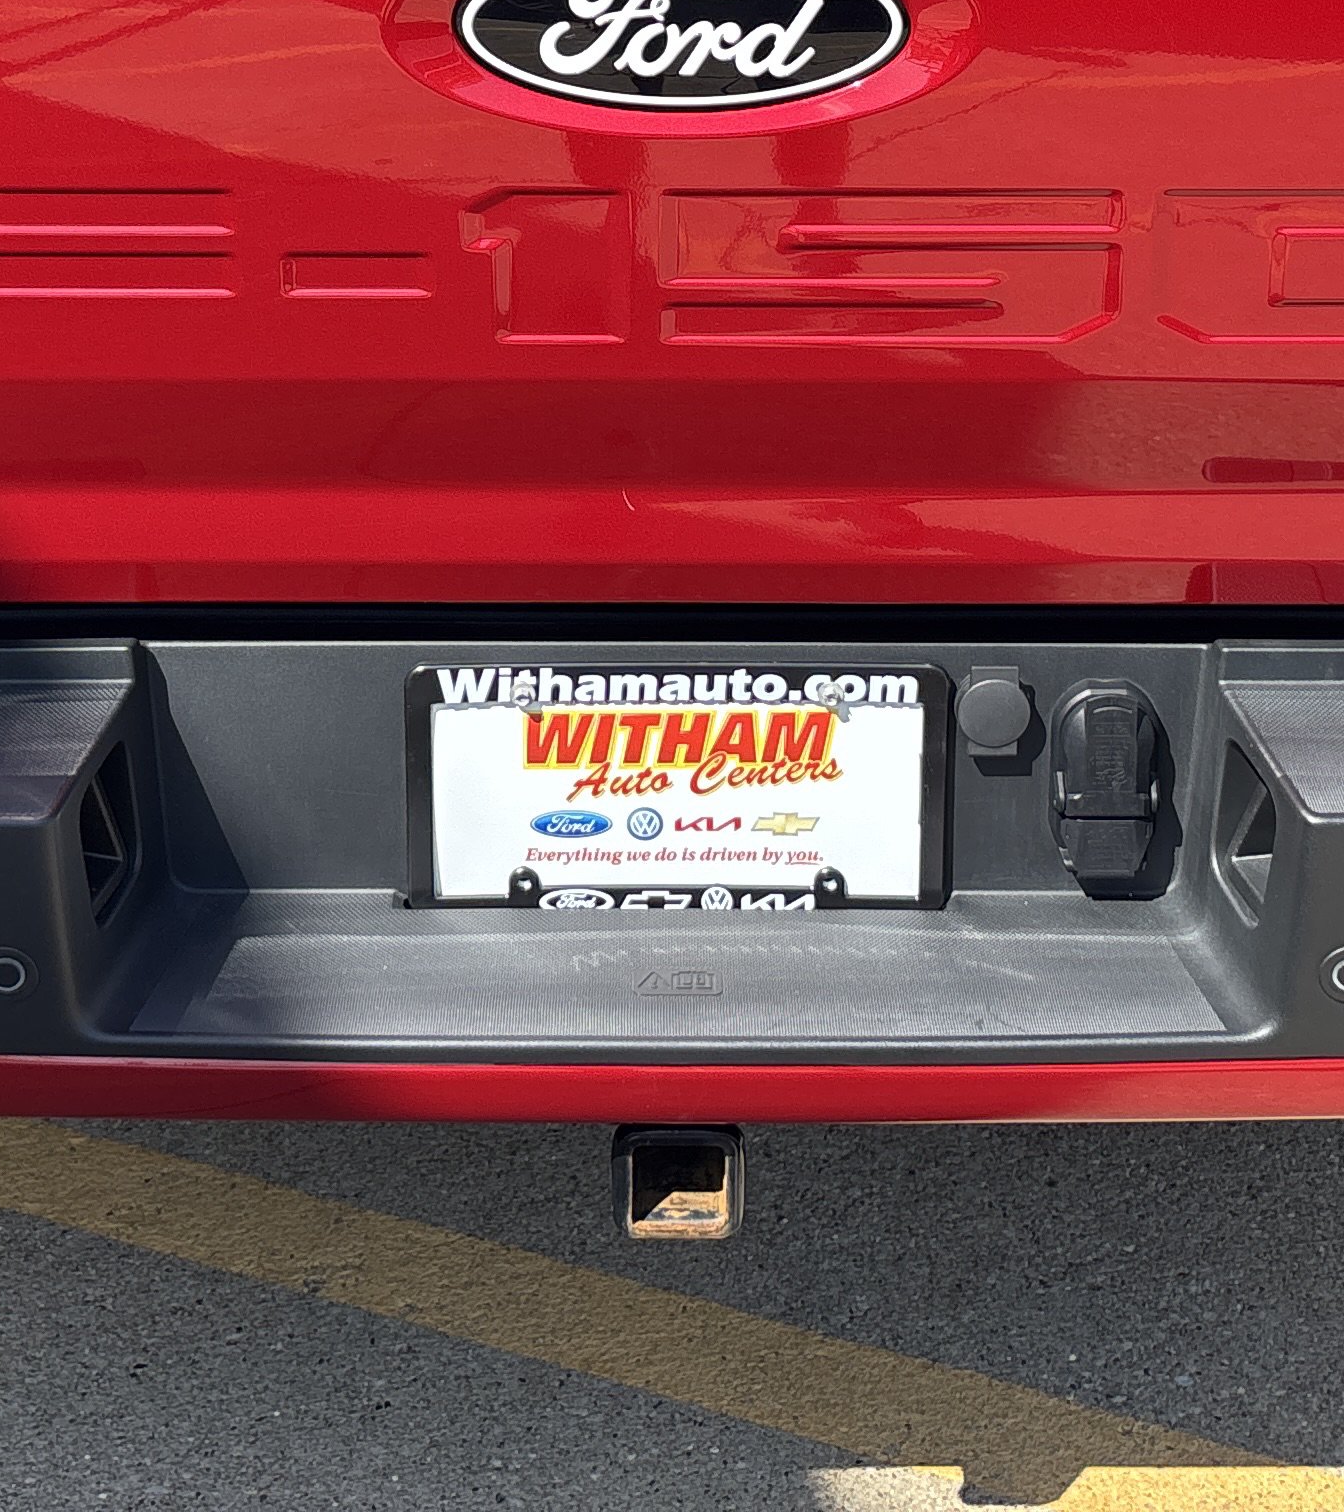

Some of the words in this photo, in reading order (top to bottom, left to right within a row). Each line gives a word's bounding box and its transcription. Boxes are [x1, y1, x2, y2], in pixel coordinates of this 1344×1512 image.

[437, 667, 918, 705] Withamauto.com
[524, 710, 836, 769] WITHAM
[566, 763, 673, 803] Auto
[689, 752, 845, 796] Centers
[525, 846, 624, 866] Everything
[626, 849, 653, 862] we
[654, 846, 677, 862] do
[682, 846, 696, 862] is
[699, 846, 757, 862] driven
[761, 846, 784, 865] by
[786, 849, 824, 866] you.
